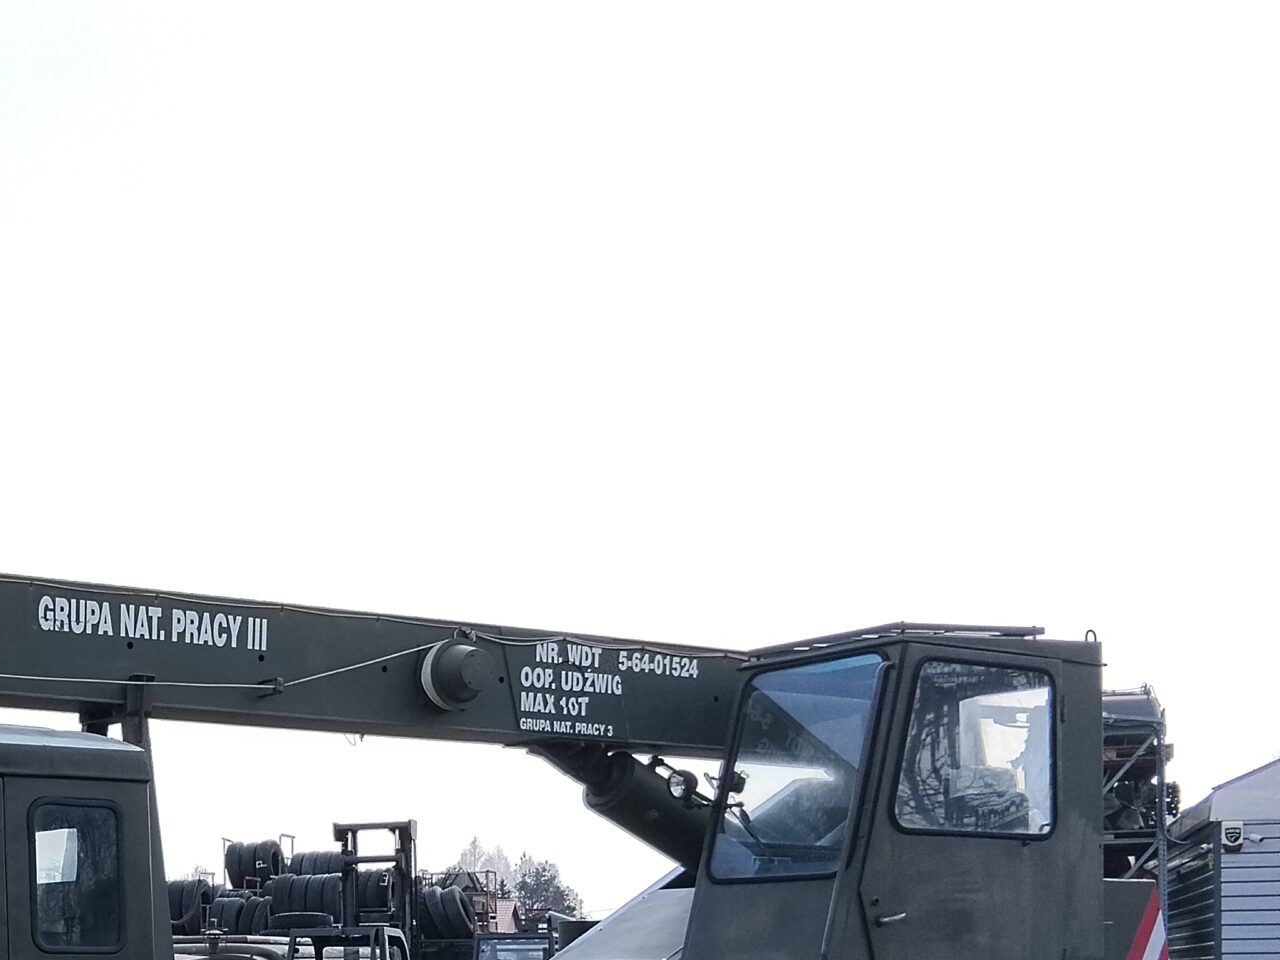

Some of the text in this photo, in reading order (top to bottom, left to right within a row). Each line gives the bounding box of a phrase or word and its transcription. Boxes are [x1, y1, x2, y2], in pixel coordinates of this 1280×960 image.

[38, 595, 268, 651] GRUPA NAT. PRACY III
[535, 642, 699, 678] NR. WDT 5-64-01524
[561, 669, 622, 695] UDŹWIG
[520, 691, 589, 716] MAX 10T
[520, 717, 613, 737] GRUPA NAT. PRACY 3
